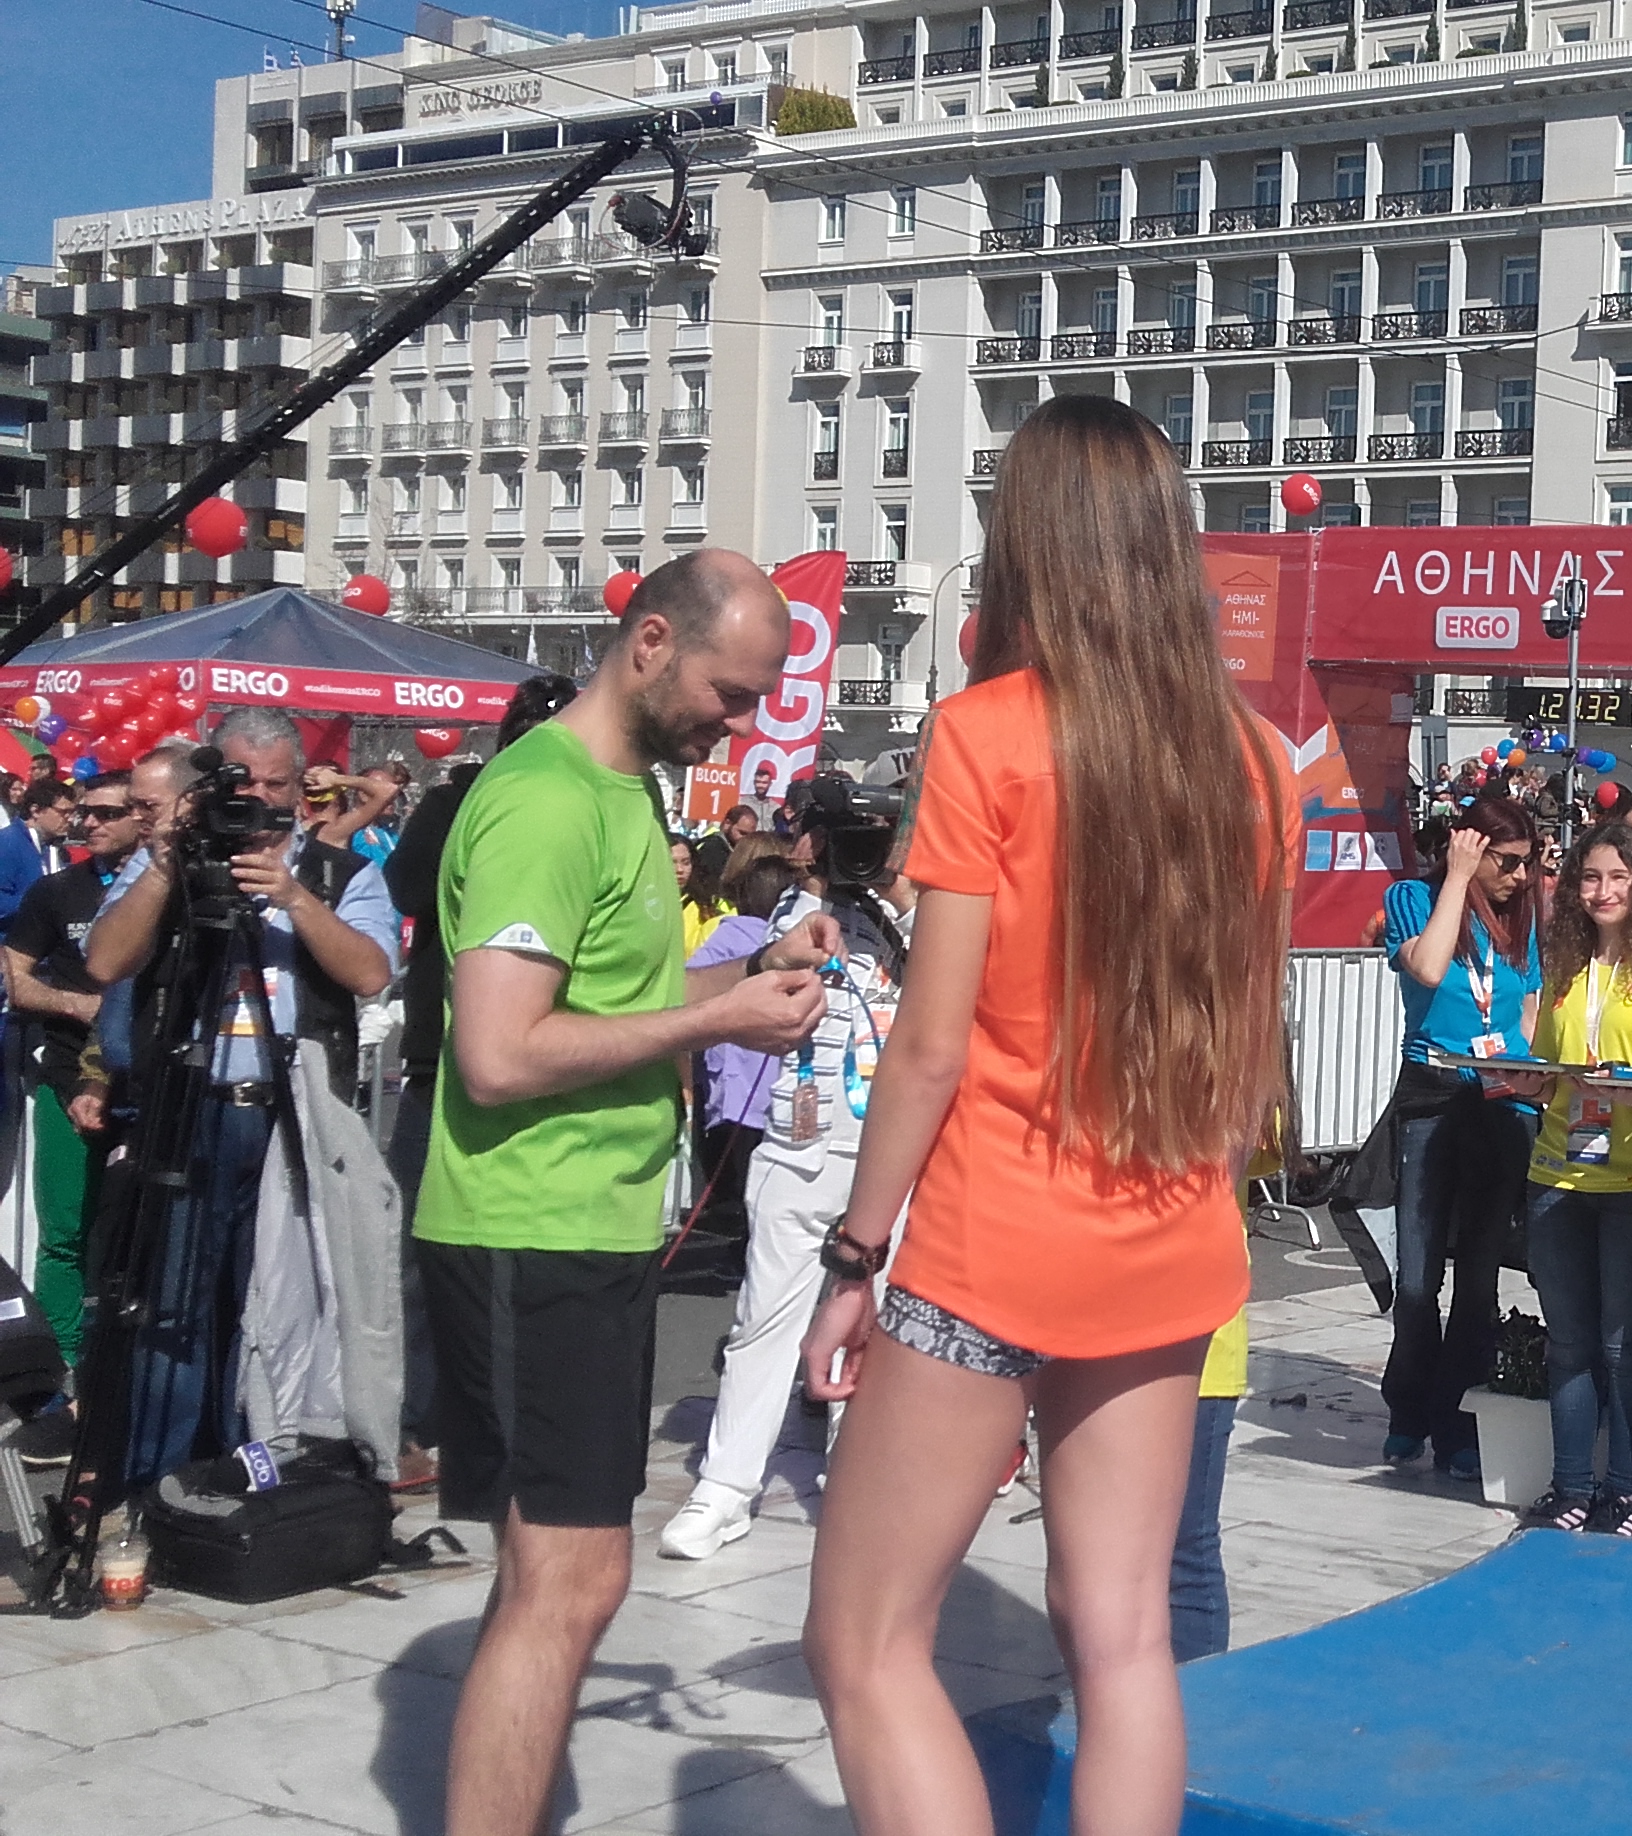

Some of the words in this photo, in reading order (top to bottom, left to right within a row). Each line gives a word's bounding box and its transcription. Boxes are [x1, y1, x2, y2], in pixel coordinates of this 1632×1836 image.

[1373, 550, 1624, 596] ΑΘΗΝΑΣ
[1225, 594, 1266, 606] ΑΘΗΝΑΣ
[1445, 615, 1510, 640] ERGO
[35, 670, 82, 694] ERGO
[211, 667, 289, 697] ERGO
[394, 681, 464, 709] ERGO
[740, 600, 832, 798] RGO
[695, 767, 736, 786] BLOCK
[710, 789, 720, 815] 1
